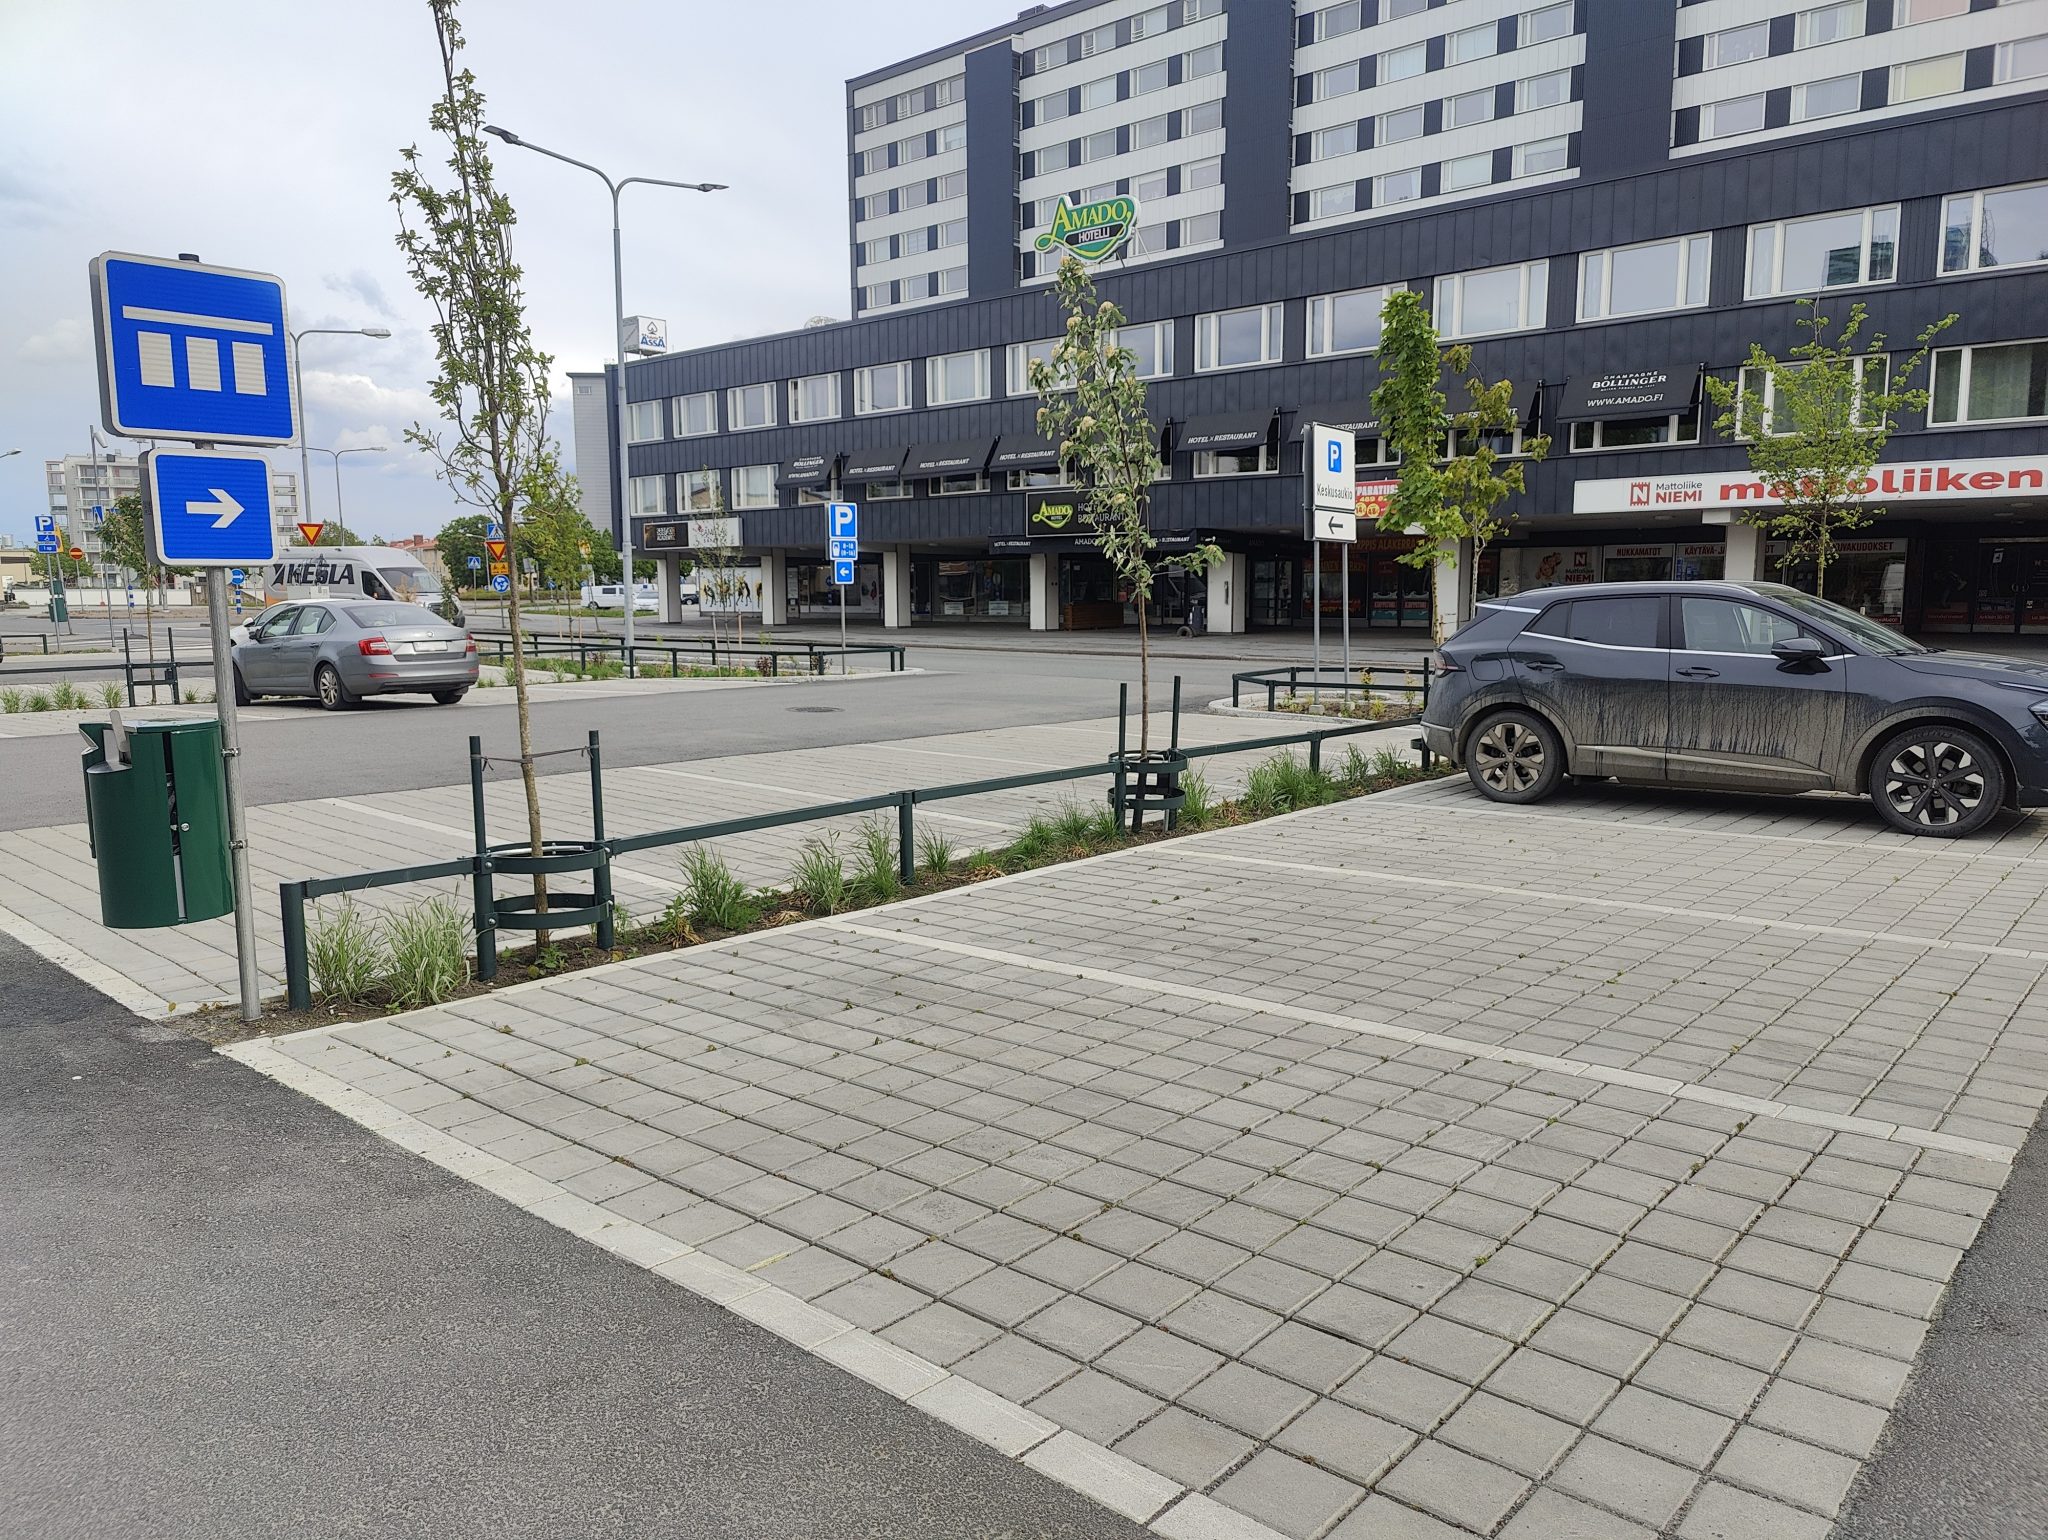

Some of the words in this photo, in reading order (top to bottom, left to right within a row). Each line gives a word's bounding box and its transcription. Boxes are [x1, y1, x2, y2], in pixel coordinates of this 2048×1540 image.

[1046, 200, 1132, 241] AMADO
[1078, 226, 1111, 243] HOTELLI
[1603, 370, 1659, 380] CHAMPAGNE
[1591, 375, 1667, 389] BOLLINGER
[1587, 393, 1664, 407] WWW.AMADO.FI
[1334, 421, 1379, 430] STAURANT
[1187, 435, 1209, 444] HOTEL
[1214, 431, 1258, 442] RESTAURANT
[999, 453, 1017, 461] HOTEL
[1020, 450, 1056, 459] RESTAURANT
[1330, 444, 1340, 469] P
[866, 465, 896, 474] RESTAURANT
[919, 461, 935, 469] HOTEL
[938, 458, 970, 467] RESTAURANT
[1316, 483, 1353, 501] Keskusaukio
[1656, 480, 1703, 492] Mattoliike
[1655, 490, 1703, 504] NIEMI
[1077, 502, 1099, 511] HOTE
[38, 517, 51, 531] P
[835, 506, 853, 536] P
[1078, 512, 1126, 523] RAURANT
[1616, 547, 1662, 557] NUKKAMATOT
[286, 563, 355, 585] KESLA
[1565, 574, 1594, 582] NIEMI
